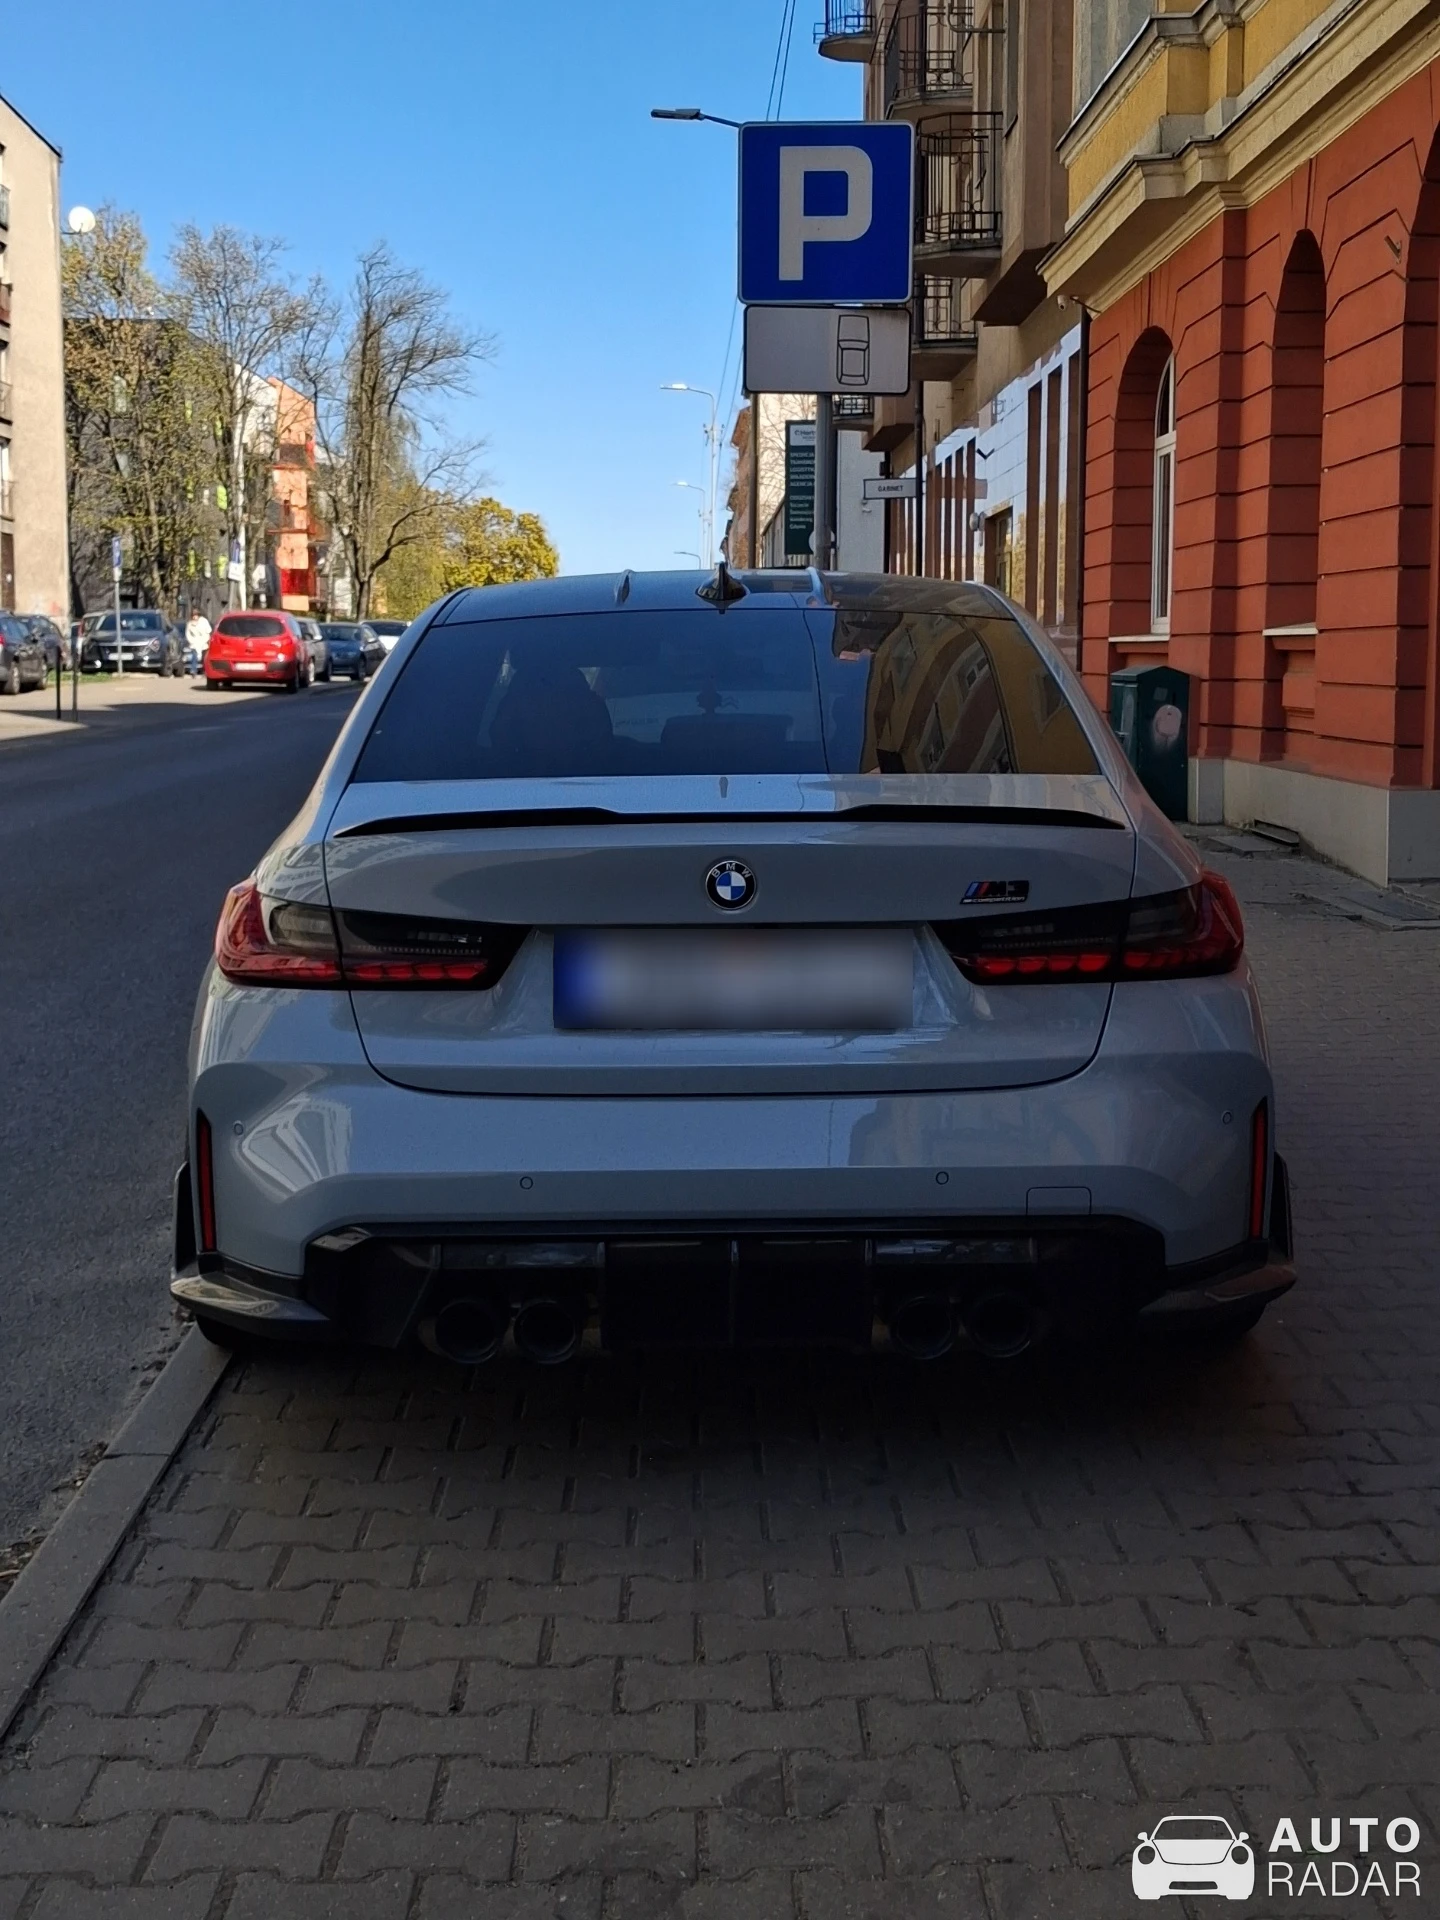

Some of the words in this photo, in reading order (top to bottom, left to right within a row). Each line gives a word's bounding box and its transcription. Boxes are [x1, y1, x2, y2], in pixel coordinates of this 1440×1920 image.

[779, 145, 873, 281] P
[711, 862, 752, 878] BMW
[978, 880, 1029, 897] M3
